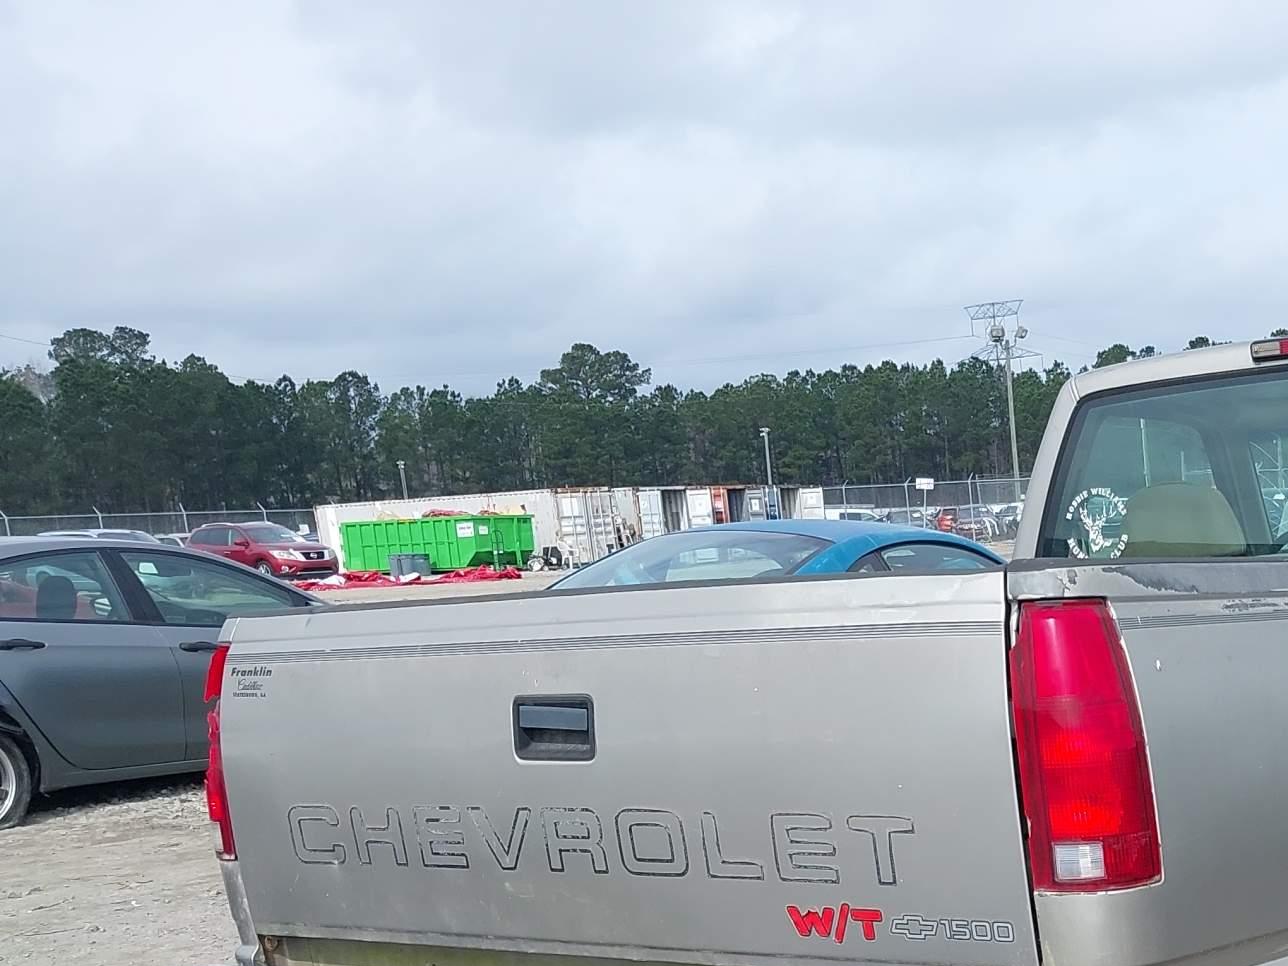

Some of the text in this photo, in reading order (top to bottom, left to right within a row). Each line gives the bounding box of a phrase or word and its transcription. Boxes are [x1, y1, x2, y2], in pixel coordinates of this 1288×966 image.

[231, 667, 272, 677] Franklin
[287, 804, 916, 887] CHEVROLET
[786, 902, 1016, 945] W/T 1500
